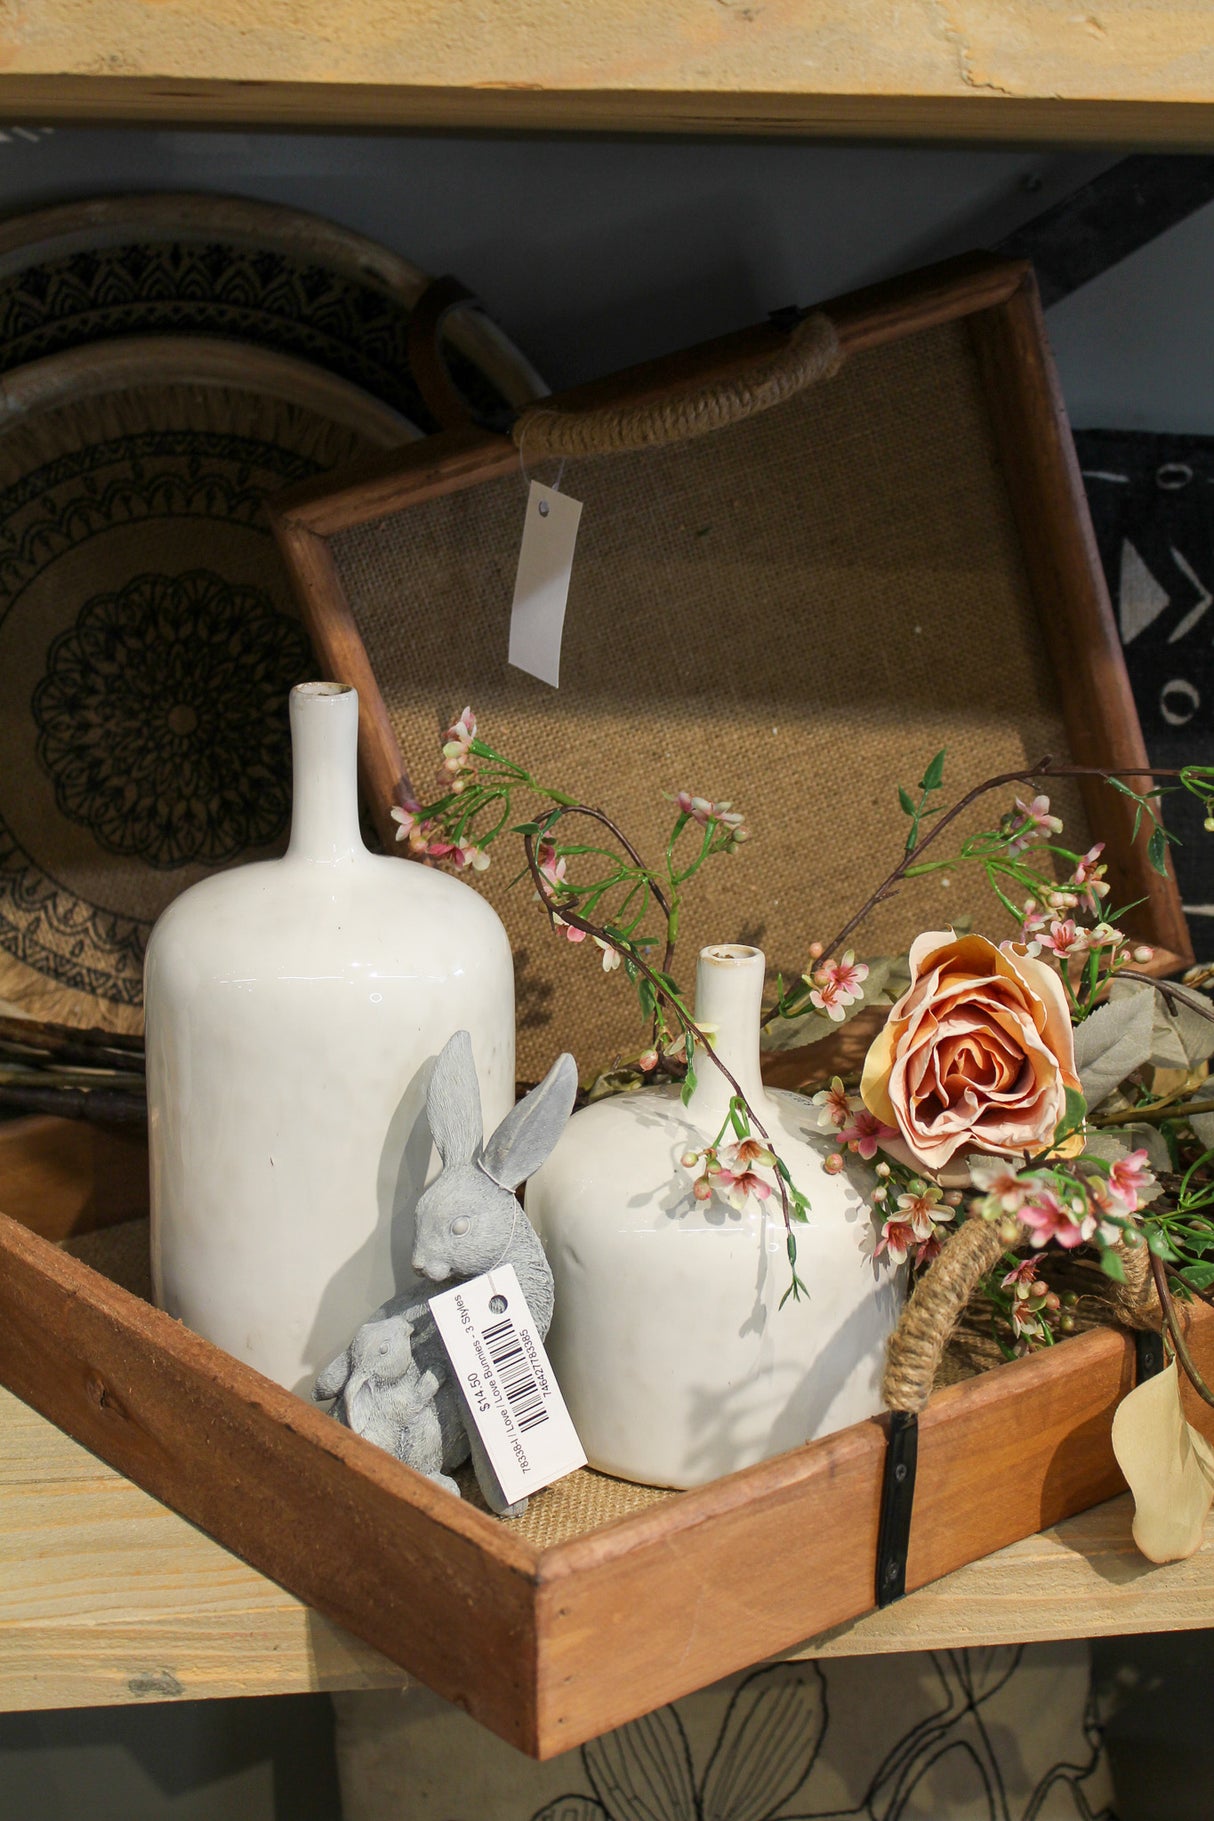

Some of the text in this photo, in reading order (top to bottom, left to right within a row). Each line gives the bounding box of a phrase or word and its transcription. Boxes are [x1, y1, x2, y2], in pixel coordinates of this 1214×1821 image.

[454, 1294, 471, 1325] Styles
[465, 1325, 474, 1334] 3
[473, 1340, 493, 1379] Bunnies
[519, 1329, 552, 1398] 746427783385
[467, 1373, 490, 1412] $14.50
[489, 1380, 503, 1404] Love
[501, 1409, 515, 1433] Love
